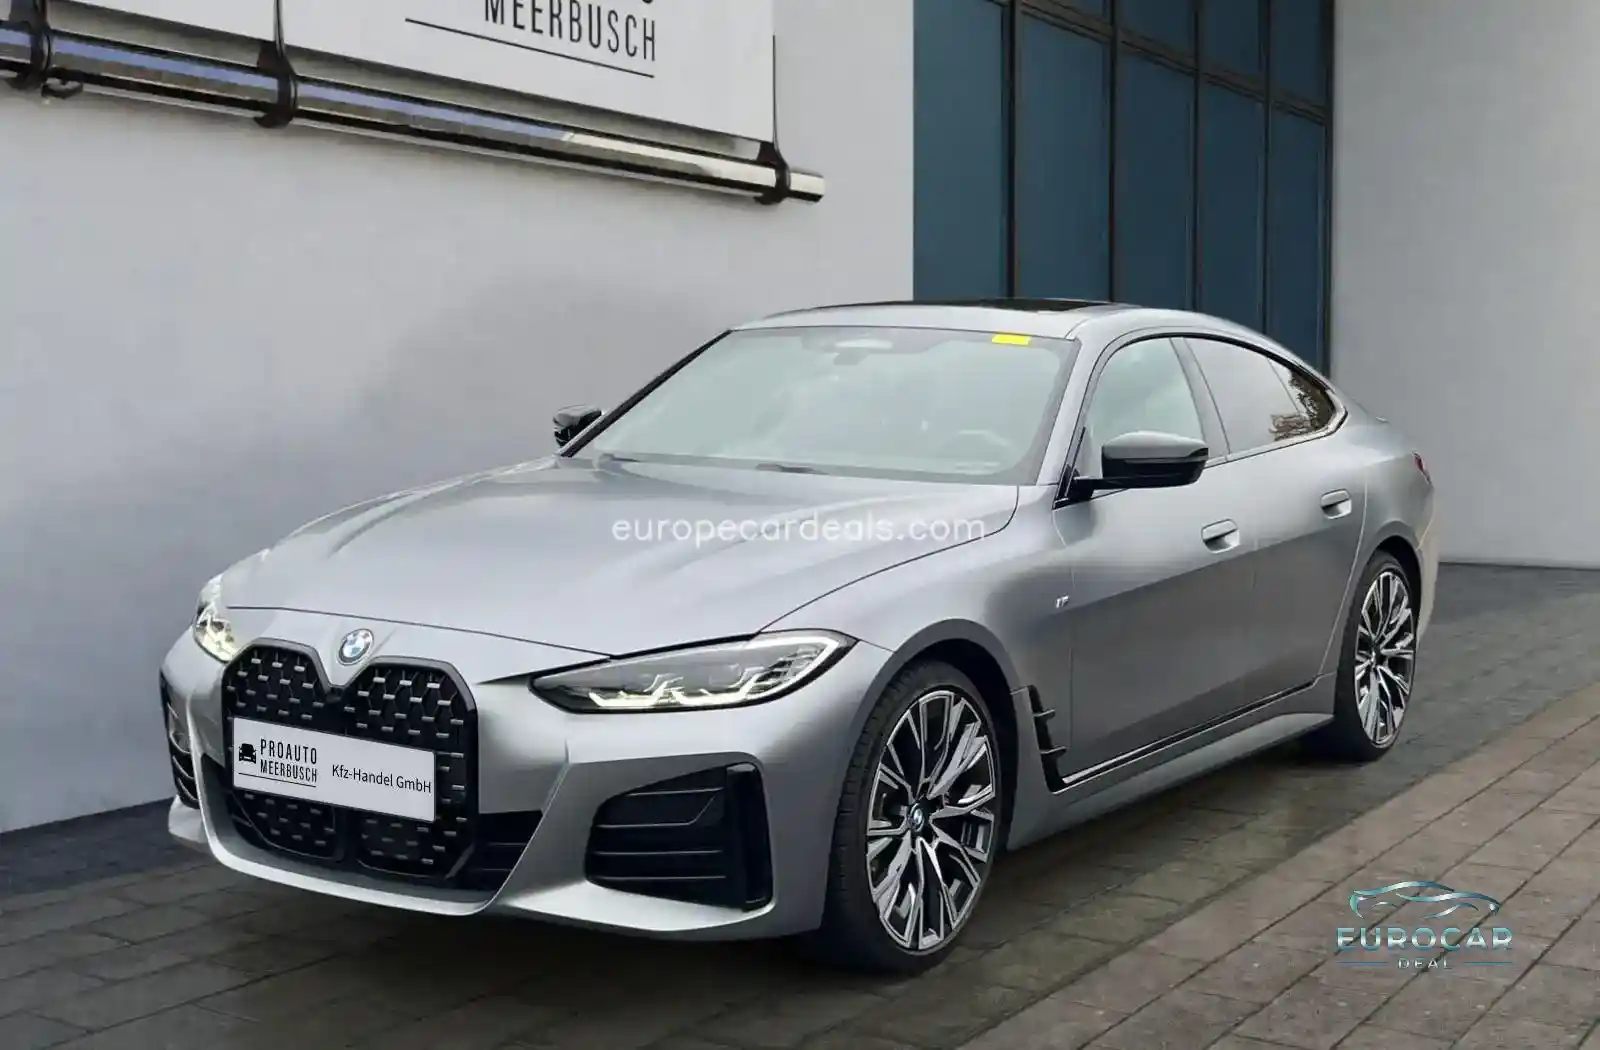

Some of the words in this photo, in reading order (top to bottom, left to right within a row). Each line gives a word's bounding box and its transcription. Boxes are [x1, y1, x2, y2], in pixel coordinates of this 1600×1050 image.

[485, 0, 656, 61] MEERBUSCH
[260, 738, 317, 764] PROAUTO
[260, 759, 318, 783] MEERBUSCH
[332, 764, 393, 787] Kfz-Handel
[396, 775, 431, 793] GmbH
